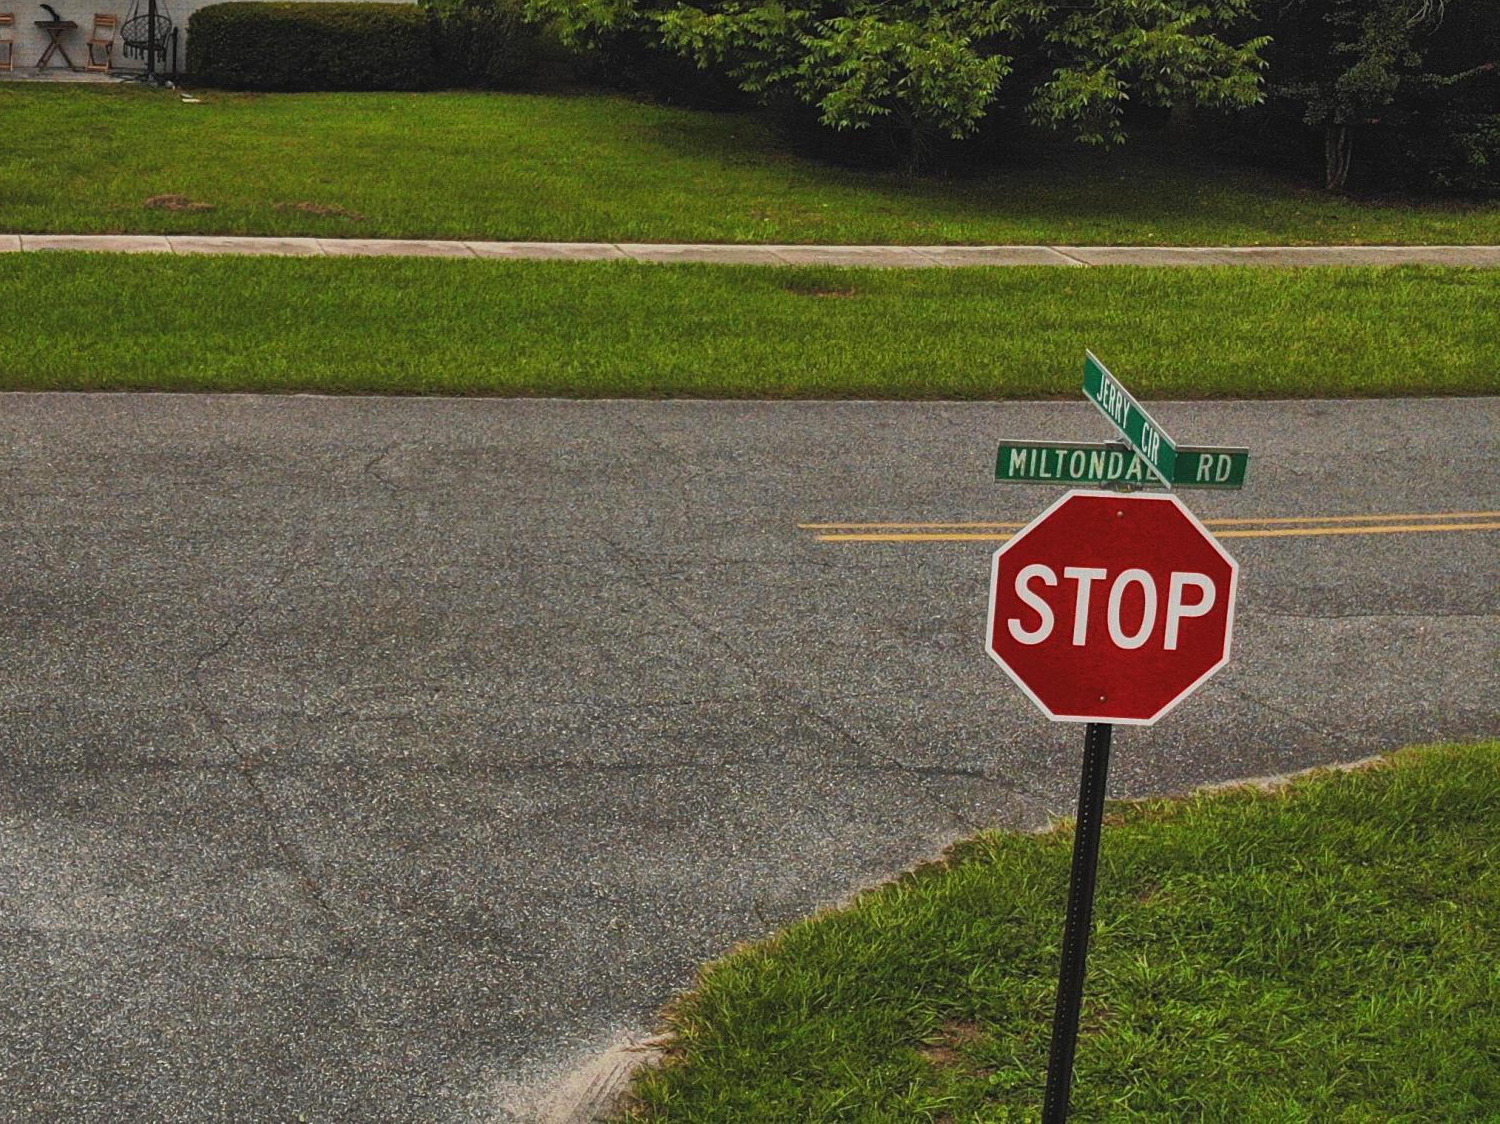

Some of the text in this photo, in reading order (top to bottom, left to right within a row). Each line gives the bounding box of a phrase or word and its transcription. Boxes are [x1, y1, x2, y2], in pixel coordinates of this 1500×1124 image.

[1097, 373, 1160, 466] JERRY CIR
[1008, 448, 1233, 483] MILTONDAL RD
[1007, 563, 1217, 651] STOP
